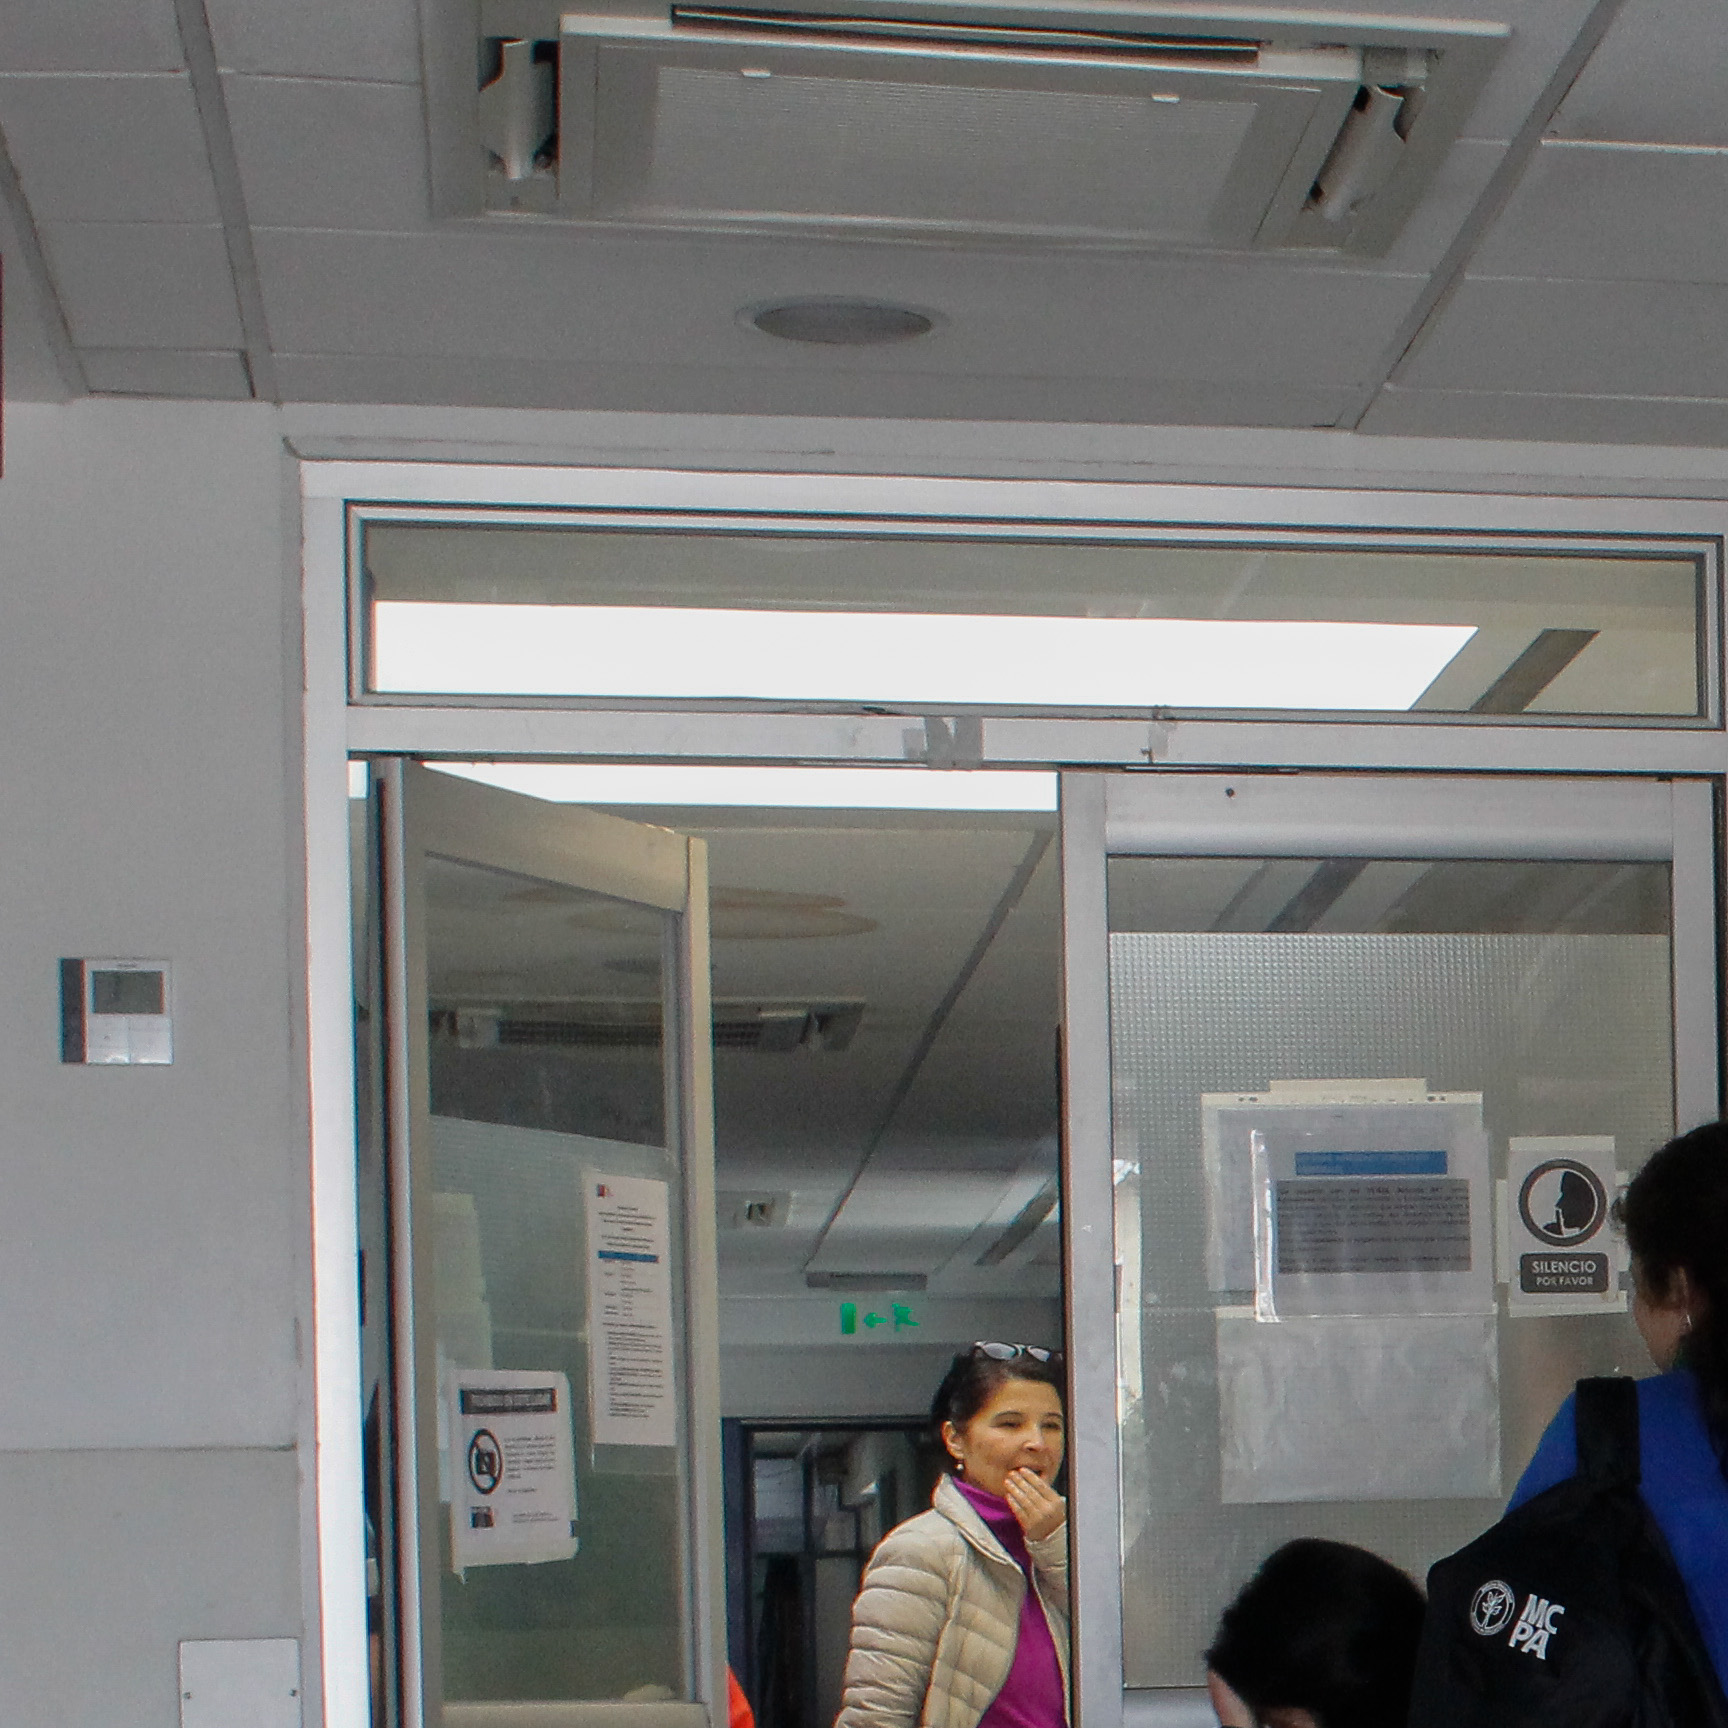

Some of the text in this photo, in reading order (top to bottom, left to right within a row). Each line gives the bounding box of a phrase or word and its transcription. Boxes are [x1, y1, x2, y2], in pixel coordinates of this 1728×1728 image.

[1531, 1260, 1597, 1275] SILENCIO
[1536, 1276, 1594, 1287] POR FAVOR
[1520, 1593, 1565, 1635] MC
[1508, 1620, 1550, 1661] PA
